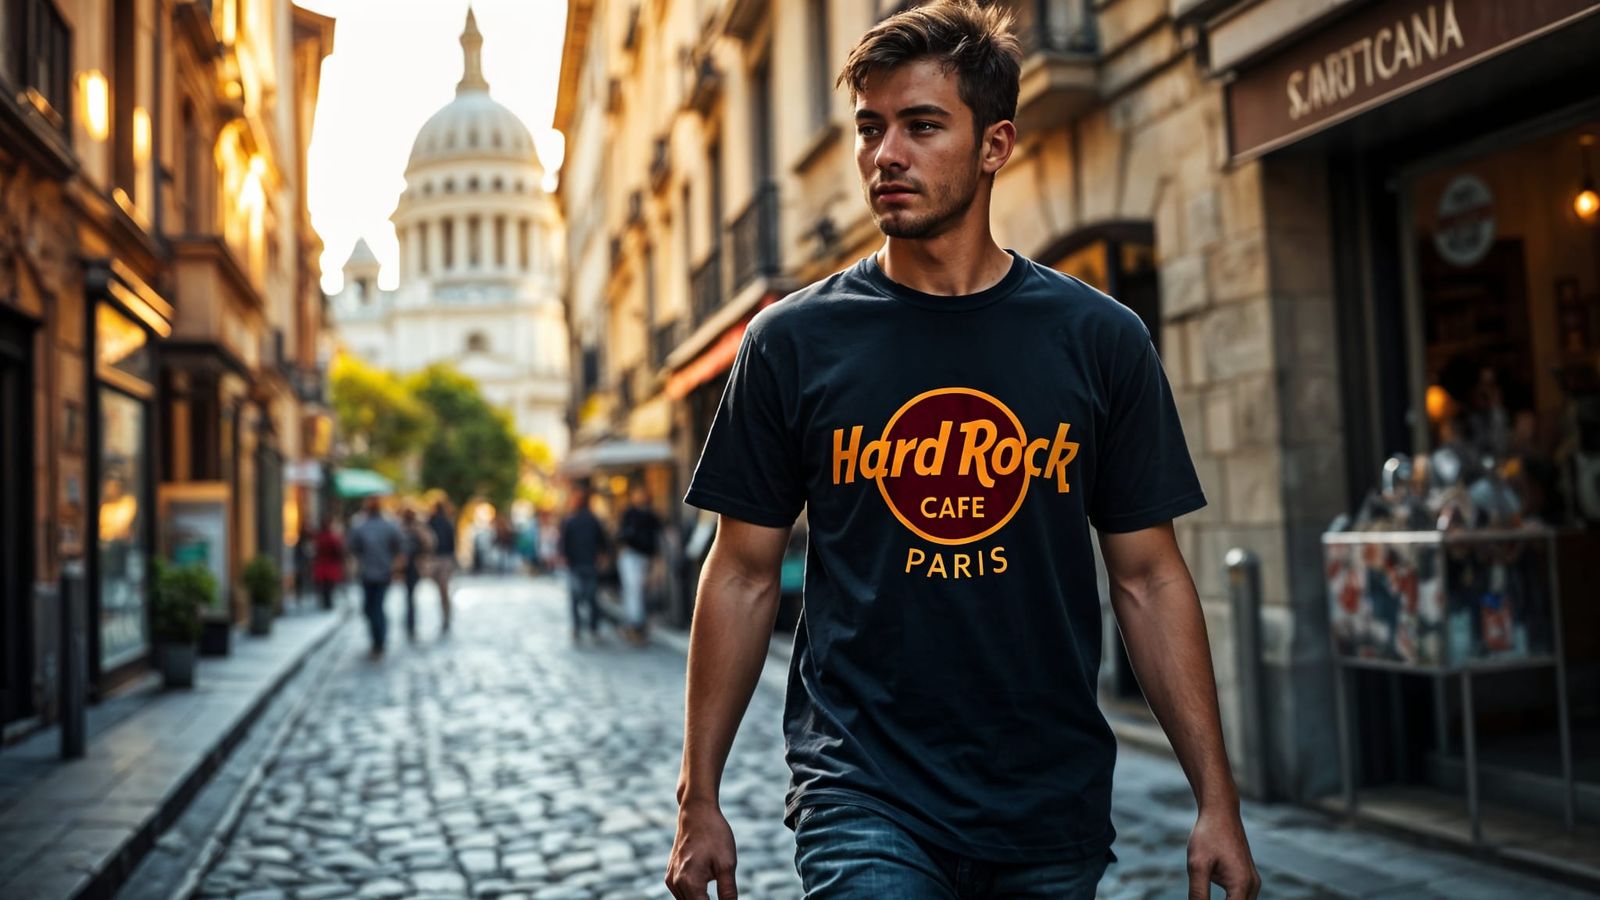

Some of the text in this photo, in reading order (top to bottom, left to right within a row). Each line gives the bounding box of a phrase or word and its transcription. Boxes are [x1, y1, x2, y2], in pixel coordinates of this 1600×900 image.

[833, 419, 1080, 493] Hard Rock
[920, 496, 985, 519] CAFE
[905, 546, 1008, 579] PARIS
